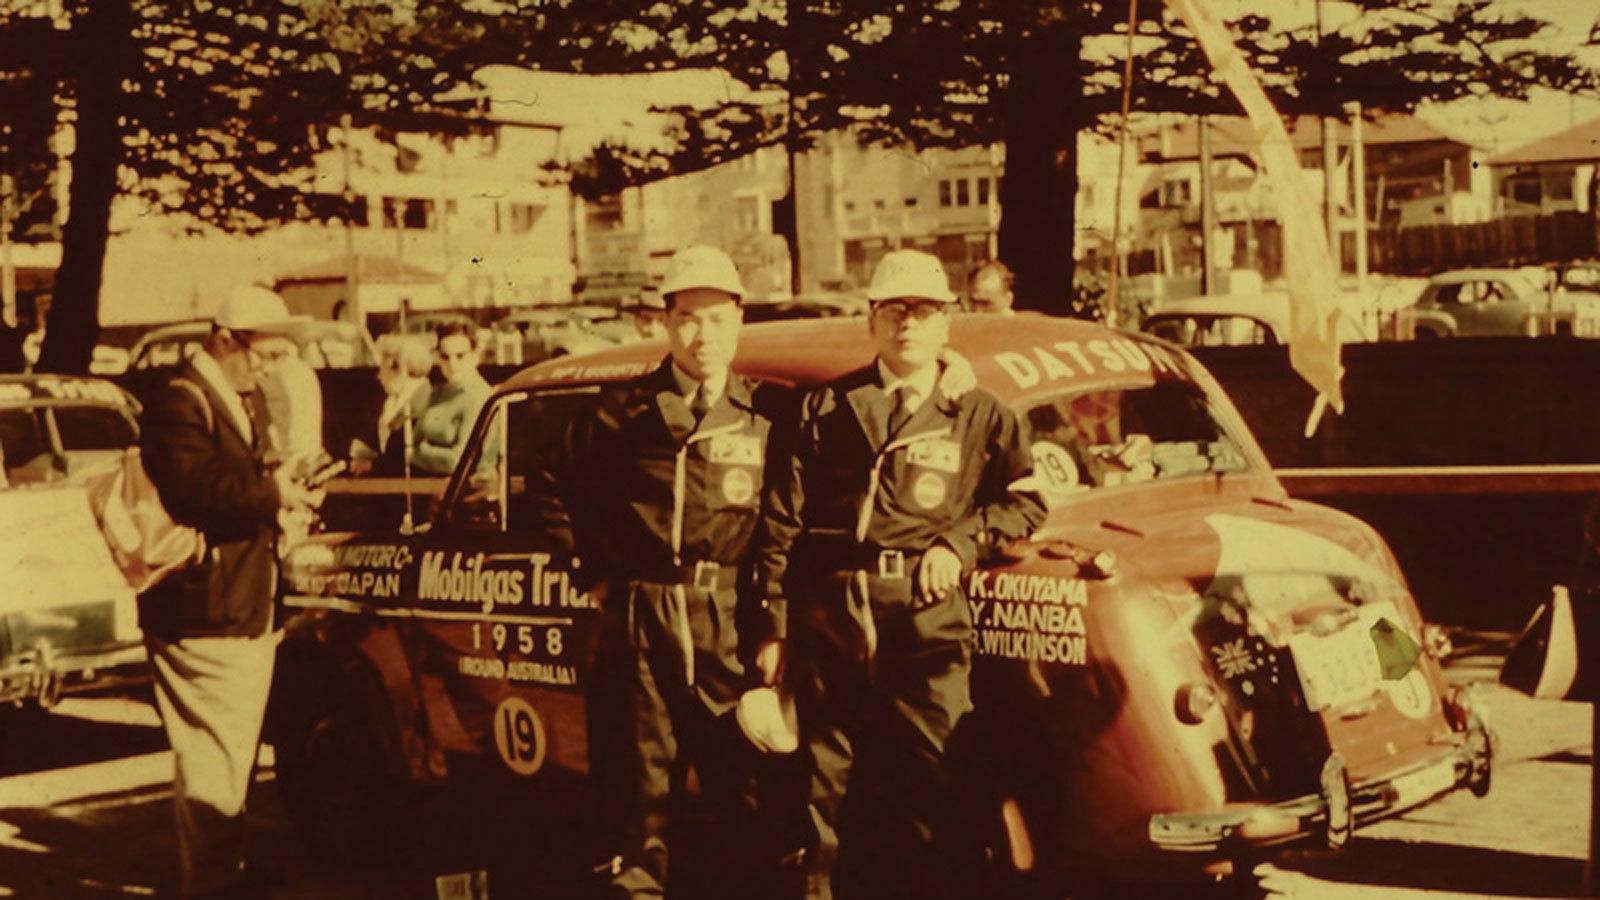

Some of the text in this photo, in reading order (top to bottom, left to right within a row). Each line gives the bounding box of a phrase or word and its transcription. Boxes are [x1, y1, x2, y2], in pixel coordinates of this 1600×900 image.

[1036, 453, 1068, 486] 19
[418, 551, 524, 615] Mobilgas
[970, 570, 1087, 607] K.OKUYAMA
[970, 600, 1086, 636] Y.NANBA
[503, 708, 537, 763] 19
